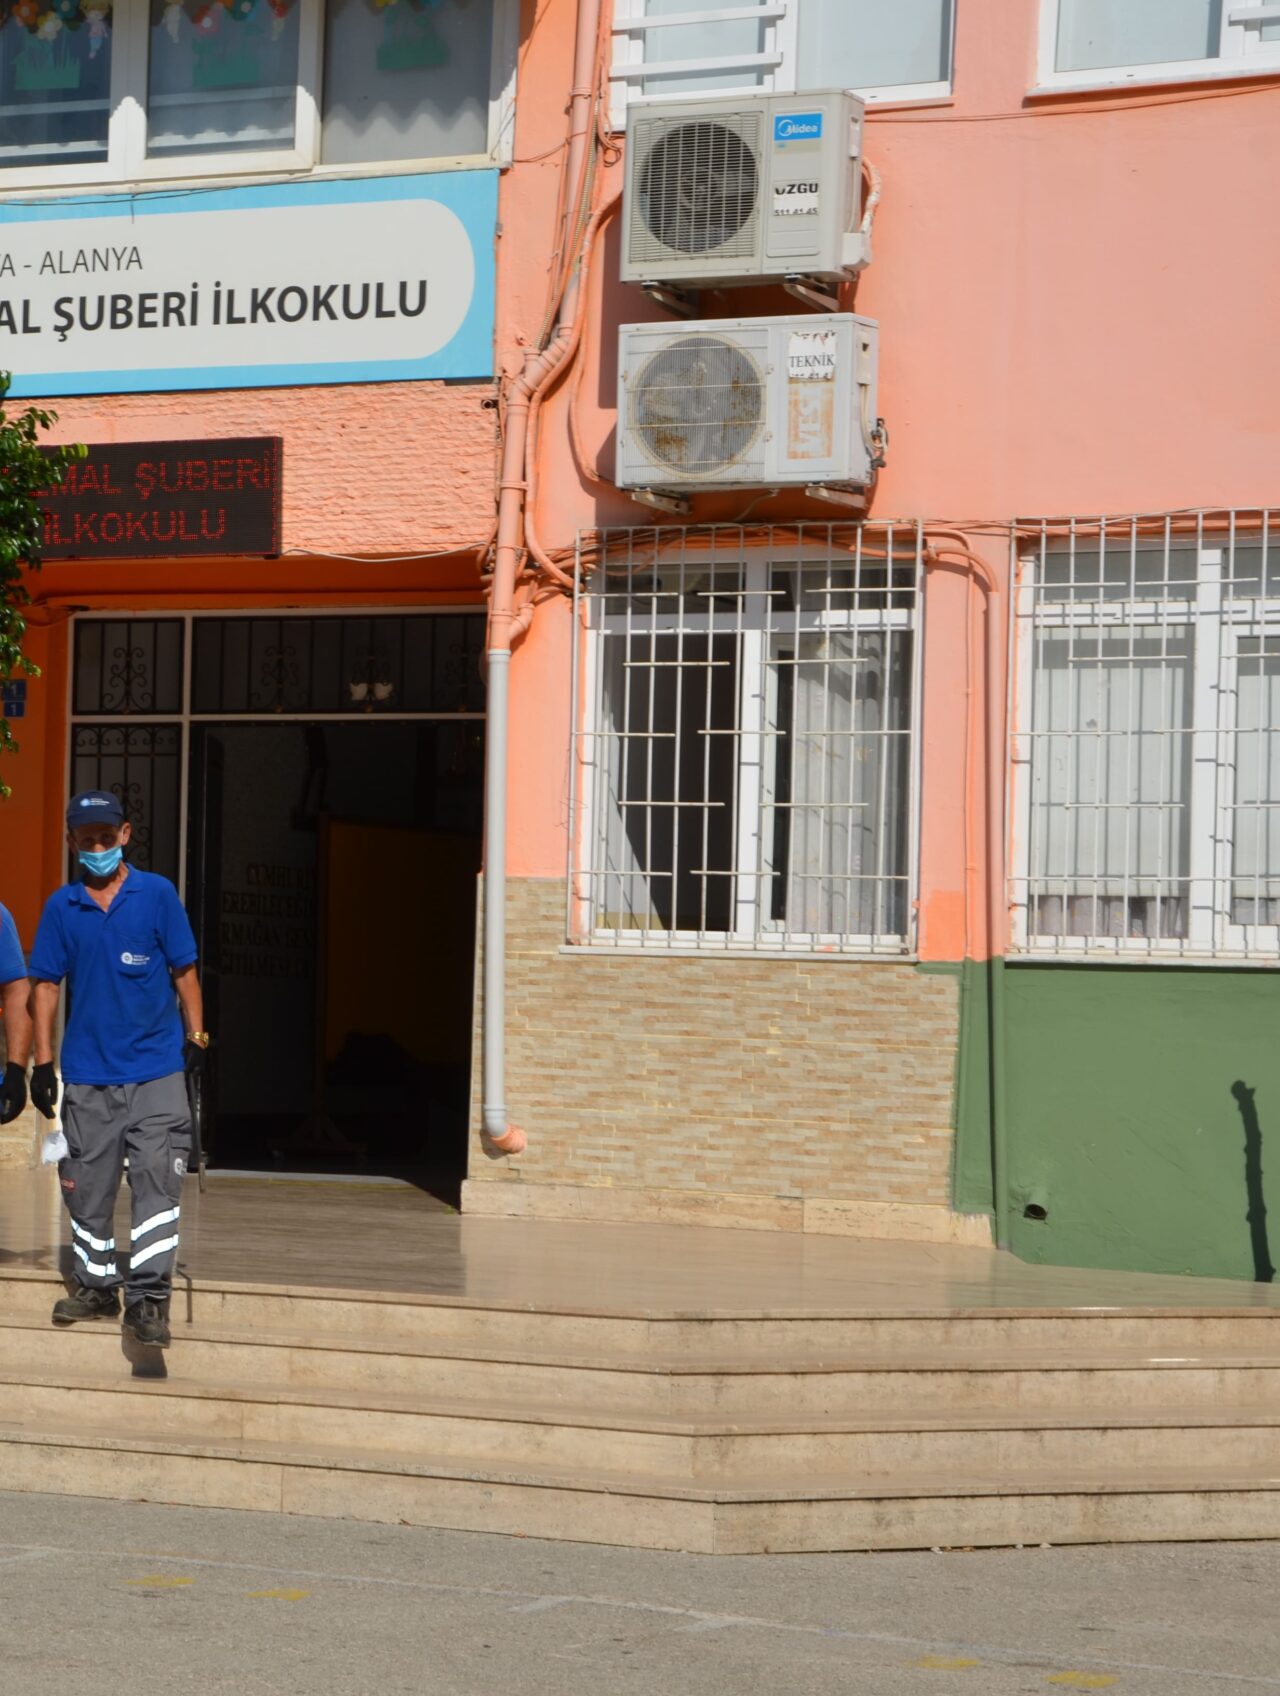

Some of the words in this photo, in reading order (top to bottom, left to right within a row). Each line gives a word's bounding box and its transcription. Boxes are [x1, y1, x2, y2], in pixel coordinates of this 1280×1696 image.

[779, 120, 818, 136] Midea
[39, 246, 143, 275] ALANYA
[53, 281, 199, 342] ŞUBERİ
[212, 280, 427, 326] İLKOKULU
[789, 352, 835, 368] TEKNİK
[28, 464, 122, 497] MAL
[134, 450, 270, 500] ŞUBERİ
[43, 507, 225, 545] İLKOKULU
